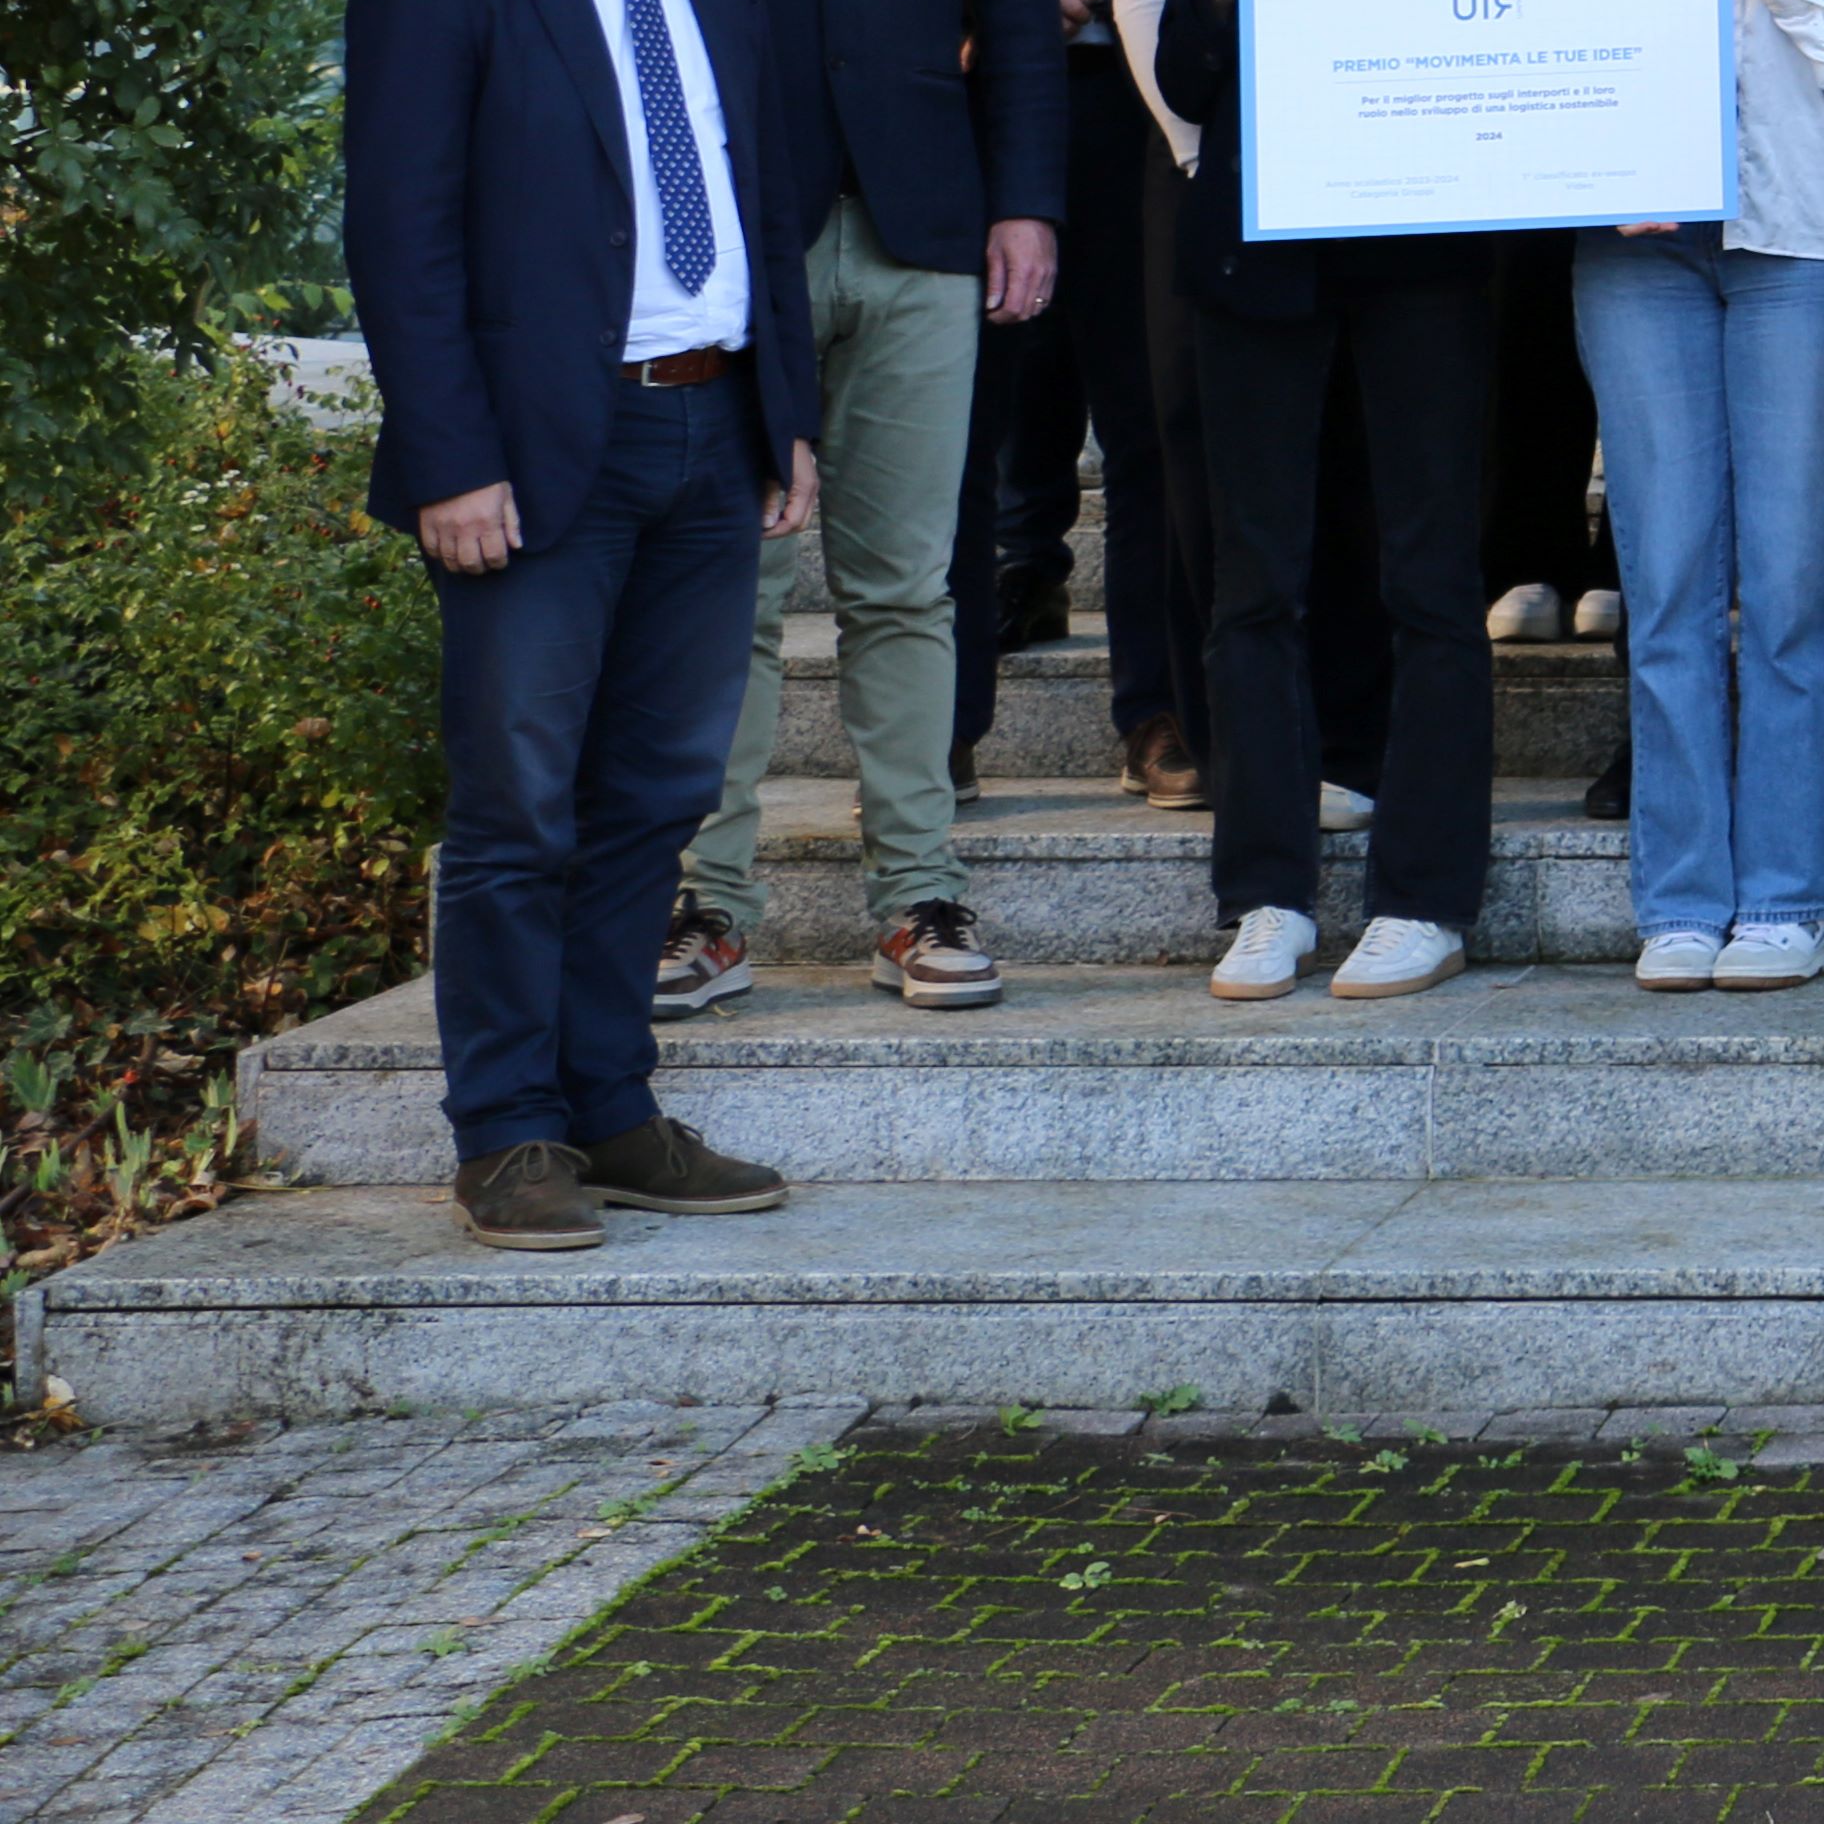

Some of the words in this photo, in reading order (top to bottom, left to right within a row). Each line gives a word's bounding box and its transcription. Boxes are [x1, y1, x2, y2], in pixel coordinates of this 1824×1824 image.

[1333, 58, 1400, 72] PREMIO
[1527, 51, 1547, 64] LE
[1553, 49, 1587, 62] TUE
[1361, 95, 1381, 105] Per
[1382, 95, 1391, 105] il
[1392, 94, 1433, 105] miglior
[1435, 91, 1485, 106] progetto
[1487, 89, 1515, 101] sugli
[1517, 87, 1571, 99] interporti
[1572, 88, 1580, 96] e
[1582, 86, 1591, 96] il
[1592, 86, 1617, 95] loro
[1358, 108, 1388, 119] ruolo
[1390, 107, 1419, 117] nello
[1420, 105, 1469, 116] sviluppo
[1471, 103, 1483, 114] di
[1485, 105, 1506, 113] una
[1508, 101, 1557, 113] logistica
[1558, 98, 1619, 110] sostenibile
[1475, 131, 1503, 142] 2024
